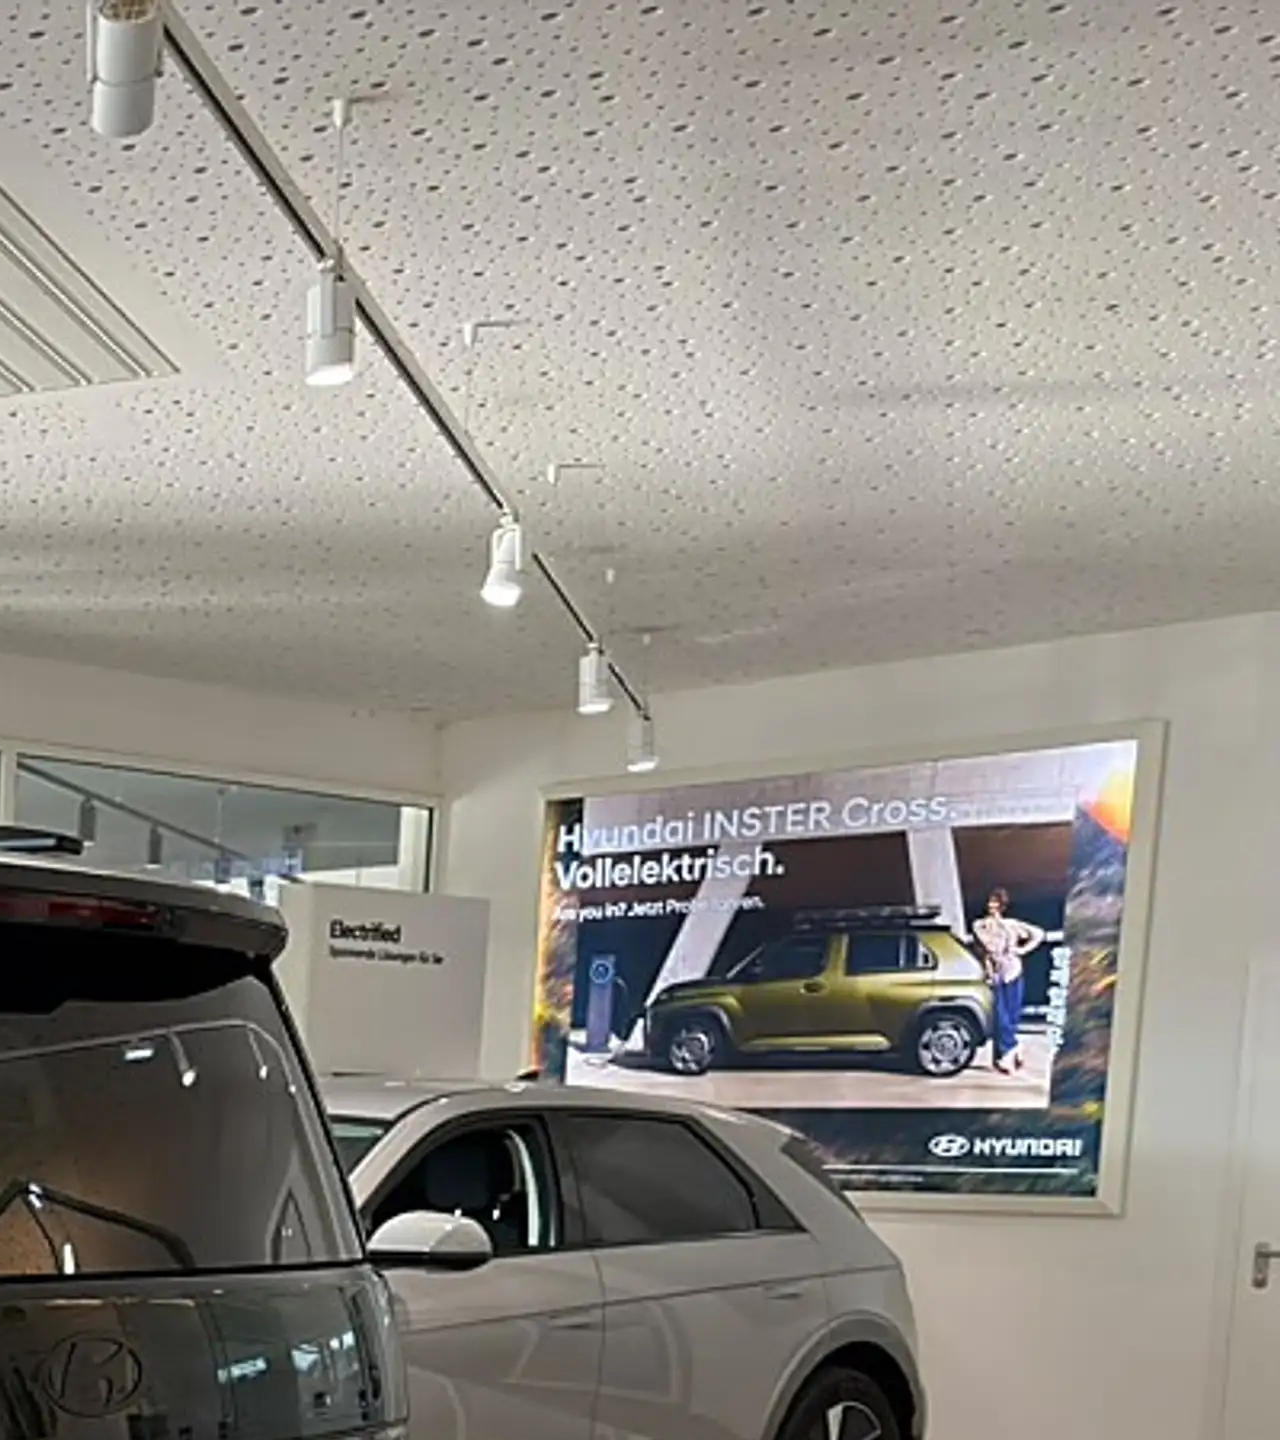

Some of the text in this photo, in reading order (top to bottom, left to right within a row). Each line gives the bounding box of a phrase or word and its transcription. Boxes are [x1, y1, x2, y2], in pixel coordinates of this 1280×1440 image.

[557, 796, 958, 856] Hyundai INSTER Cross.
[555, 844, 786, 891] Vollelektrisch.
[972, 1137, 1083, 1157] HYUNDAI
